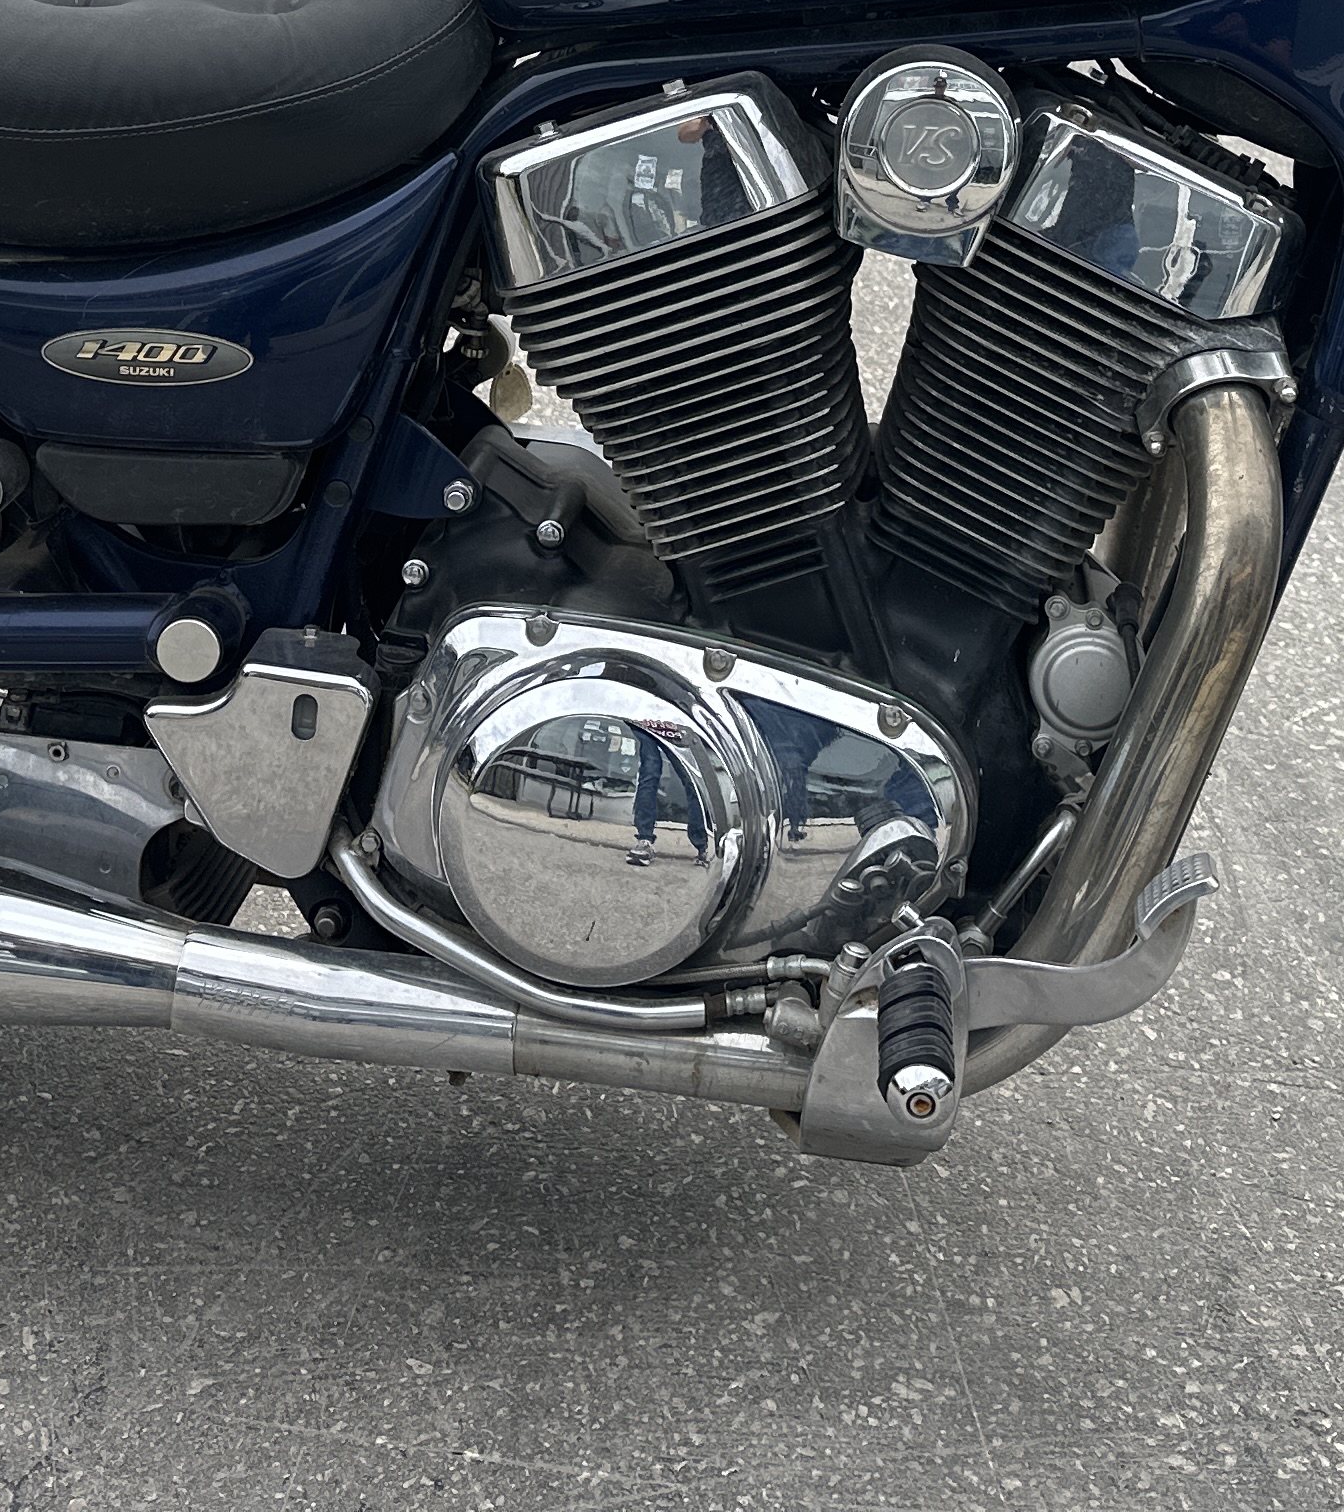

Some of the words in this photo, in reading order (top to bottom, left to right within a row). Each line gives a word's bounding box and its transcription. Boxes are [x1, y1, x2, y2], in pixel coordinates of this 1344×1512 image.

[897, 124, 963, 171] VS
[76, 339, 214, 364] 1400
[118, 364, 175, 377] SUZUKI
